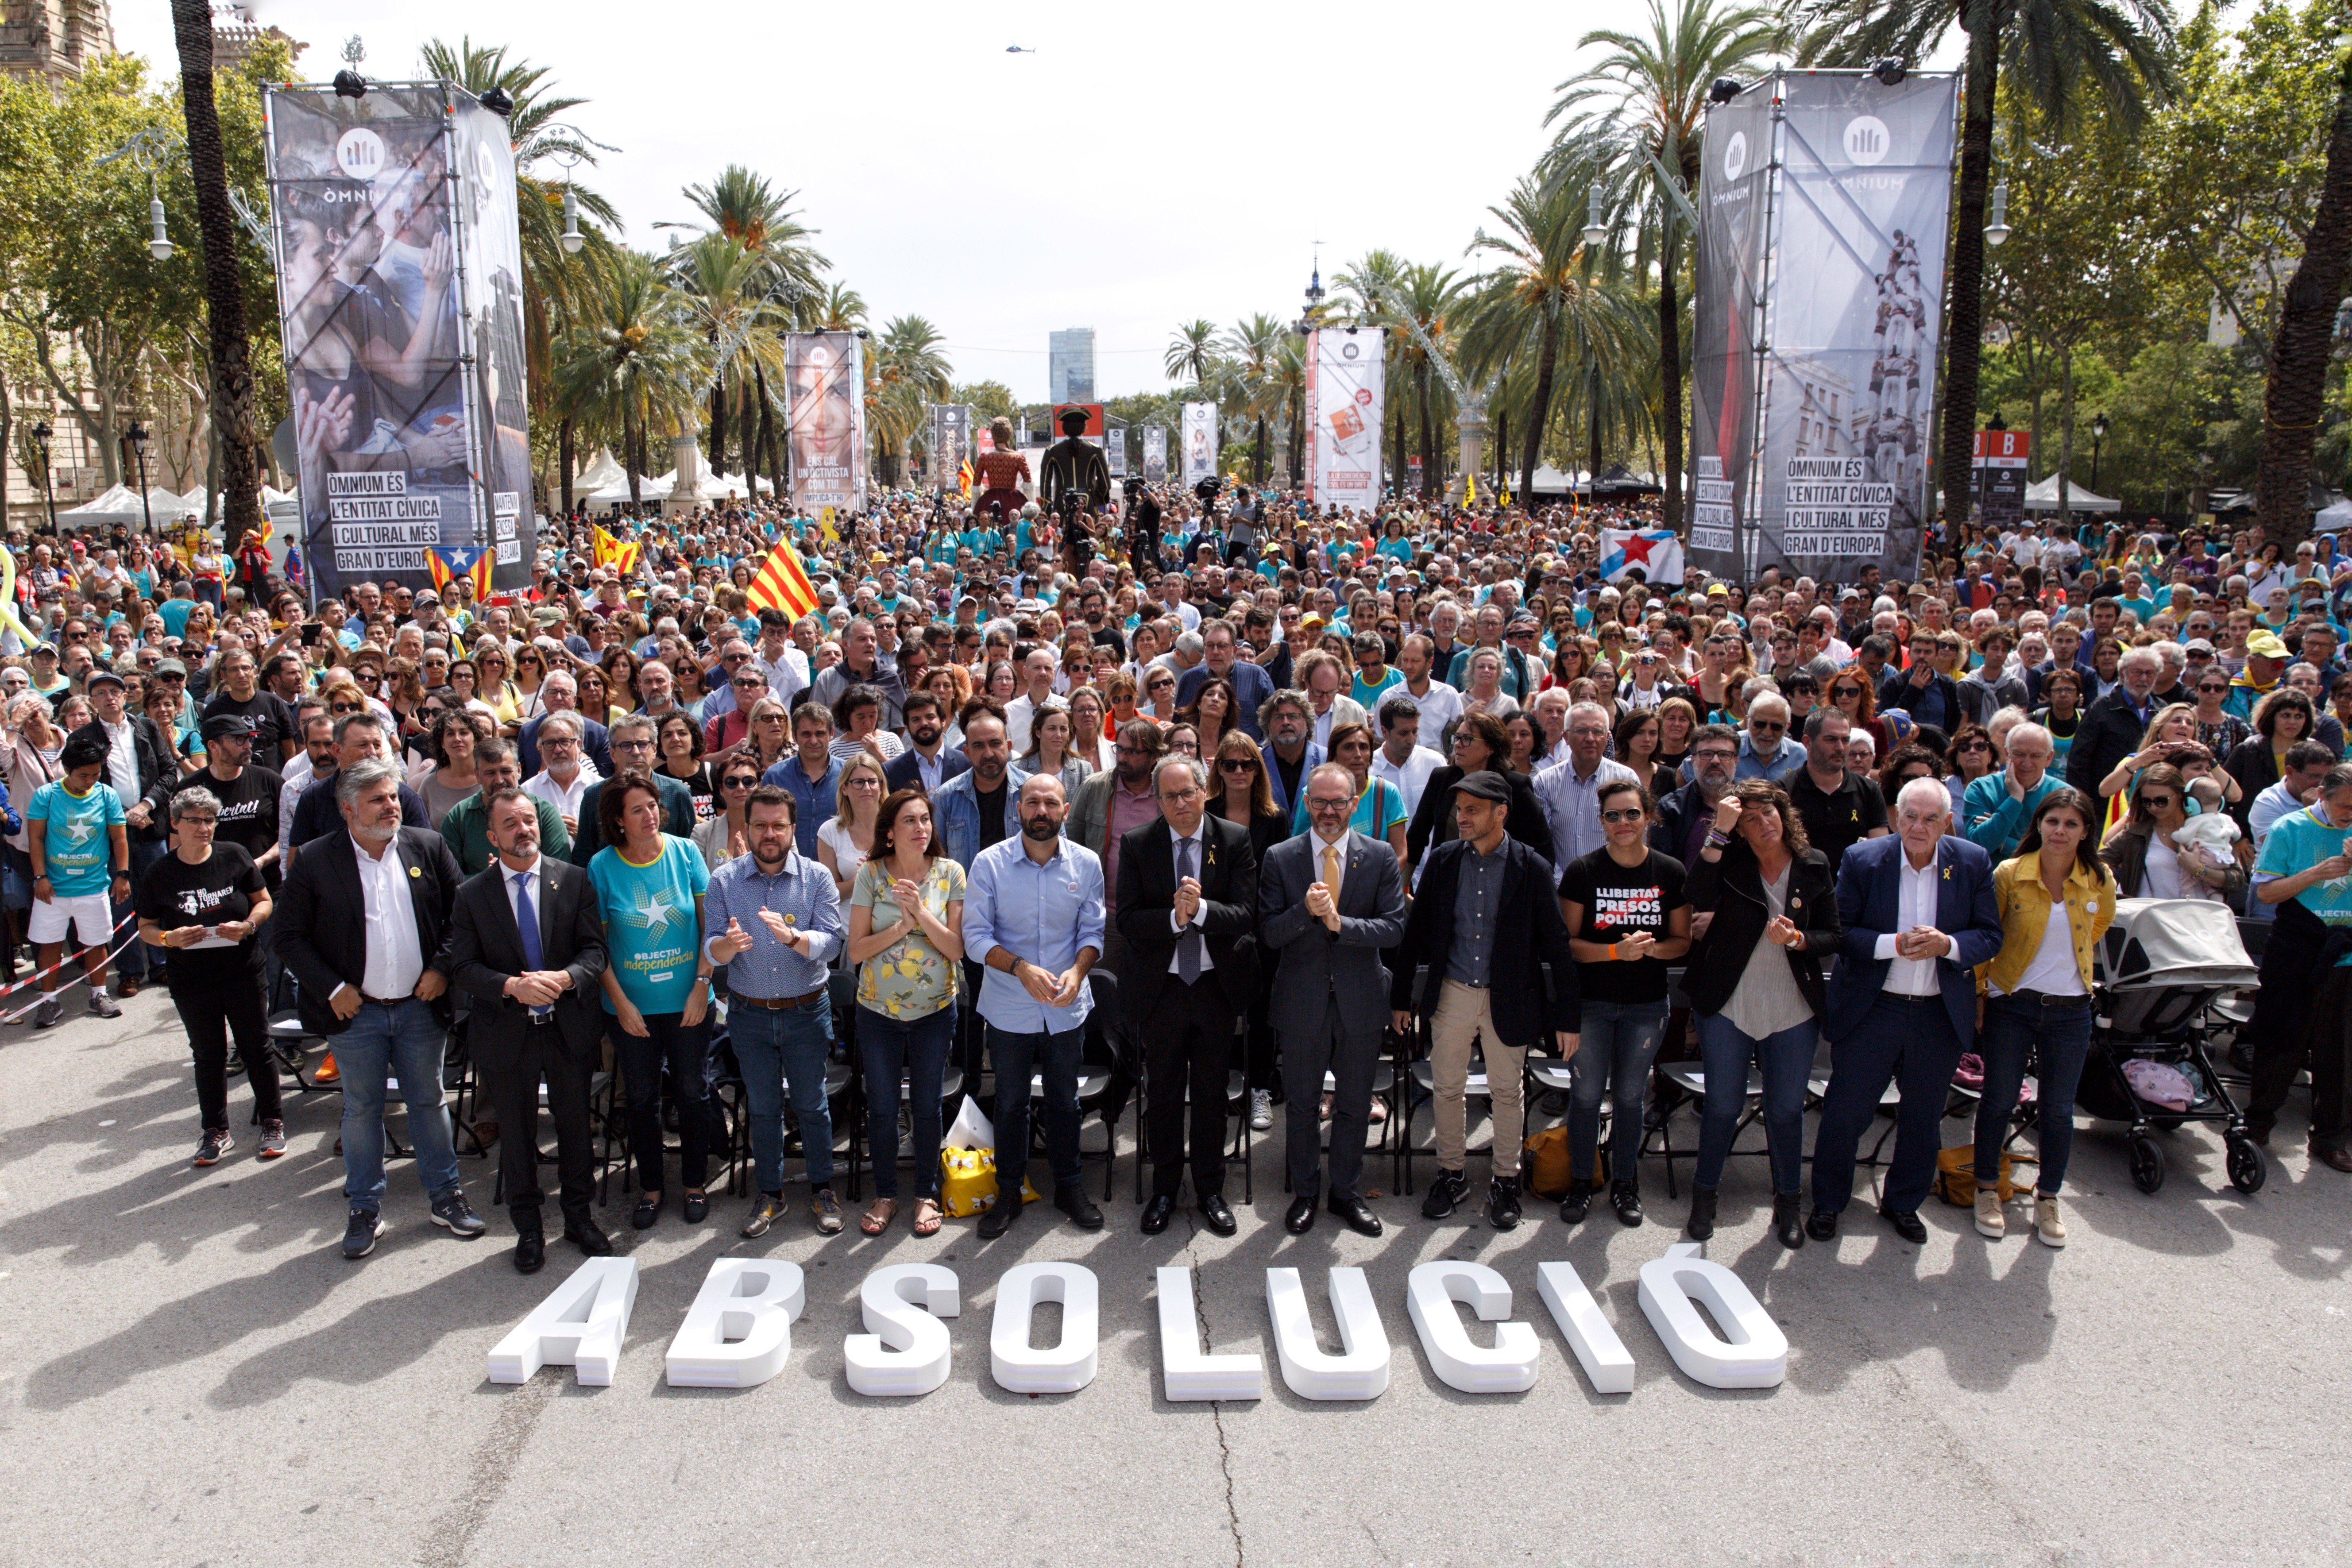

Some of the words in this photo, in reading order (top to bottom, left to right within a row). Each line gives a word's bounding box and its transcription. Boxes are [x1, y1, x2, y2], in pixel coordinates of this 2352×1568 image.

[1713, 186, 1749, 206] ÒMNIUM
[2003, 433, 2015, 455] B
[807, 456, 822, 467] ENS
[824, 456, 838, 466] CAL
[1788, 457, 1842, 477] ÒMNIUM
[1845, 458, 1862, 477] ÉS
[797, 468, 808, 478] UN
[329, 473, 383, 493] ÒMNIUM
[388, 472, 403, 492] ÉS
[808, 479, 825, 490] COM
[826, 479, 839, 489] TU!
[1697, 483, 1719, 499] L'ENTITAT
[805, 494, 843, 502] IMPLICA-T'HI
[1787, 486, 1847, 502] L'ENTITAT
[1850, 483, 1892, 502] CÍVICA
[332, 501, 393, 518] L'ENTITAT
[397, 497, 440, 518] CÍVICA
[495, 494, 518, 511] MANTENIM
[1695, 507, 1698, 521] I
[1698, 507, 1722, 524] CULTURAL
[1786, 512, 1789, 528] I
[1793, 512, 1854, 528] CULTURAL
[1858, 509, 1886, 528] MÉS
[334, 528, 338, 544] I
[342, 526, 406, 544] CULTURAL
[410, 522, 437, 542] MÉS
[497, 519, 514, 536] ENCESA
[1692, 530, 1707, 547] GRAN
[1708, 532, 1732, 549] D'EUROPA
[1785, 537, 1817, 552] GRAN
[1821, 537, 1881, 552] D'EUROPA
[498, 545, 503, 560] LA
[505, 543, 519, 560] FLAMA
[337, 552, 374, 569] GRAN
[692, 795, 713, 803] RTAT
[197, 888, 207, 898] HO
[1596, 888, 1660, 898] LLIBERTAT
[206, 898, 220, 908] FER
[1596, 899, 1661, 912] PRESOS
[1595, 912, 1662, 925] POLÍTICS!
[624, 950, 693, 976] independència
[488, 1242, 1789, 1402] ABSOLUCIÓ
